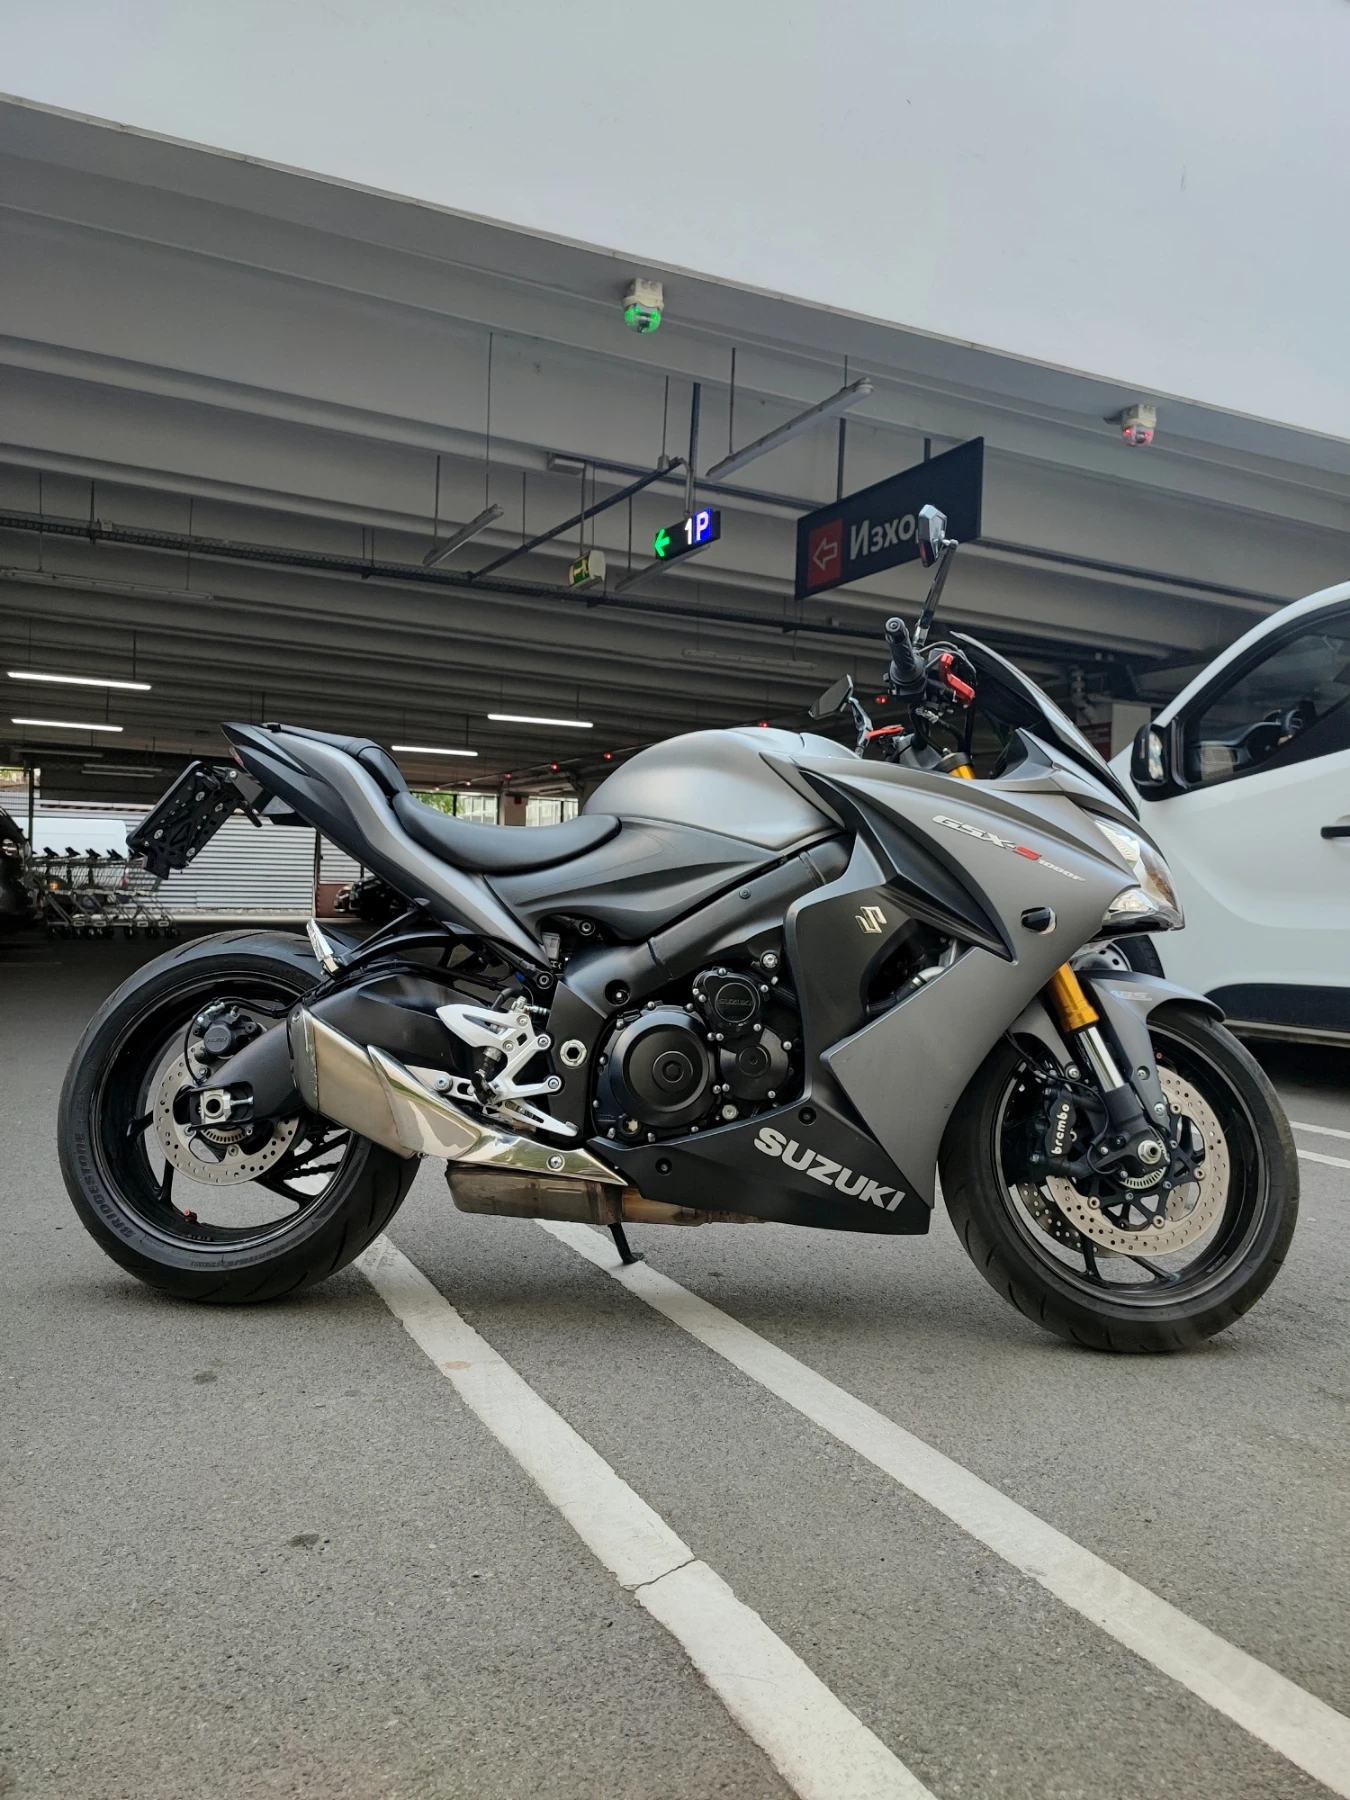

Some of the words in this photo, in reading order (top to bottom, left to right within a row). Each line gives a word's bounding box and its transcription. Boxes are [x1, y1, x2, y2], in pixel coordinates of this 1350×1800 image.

[850, 514, 920, 560] Изхо
[1050, 1104, 1070, 1154] brembo
[74, 1132, 137, 1239] BRIDGESTONE
[754, 1127, 906, 1212] SUZUKI
